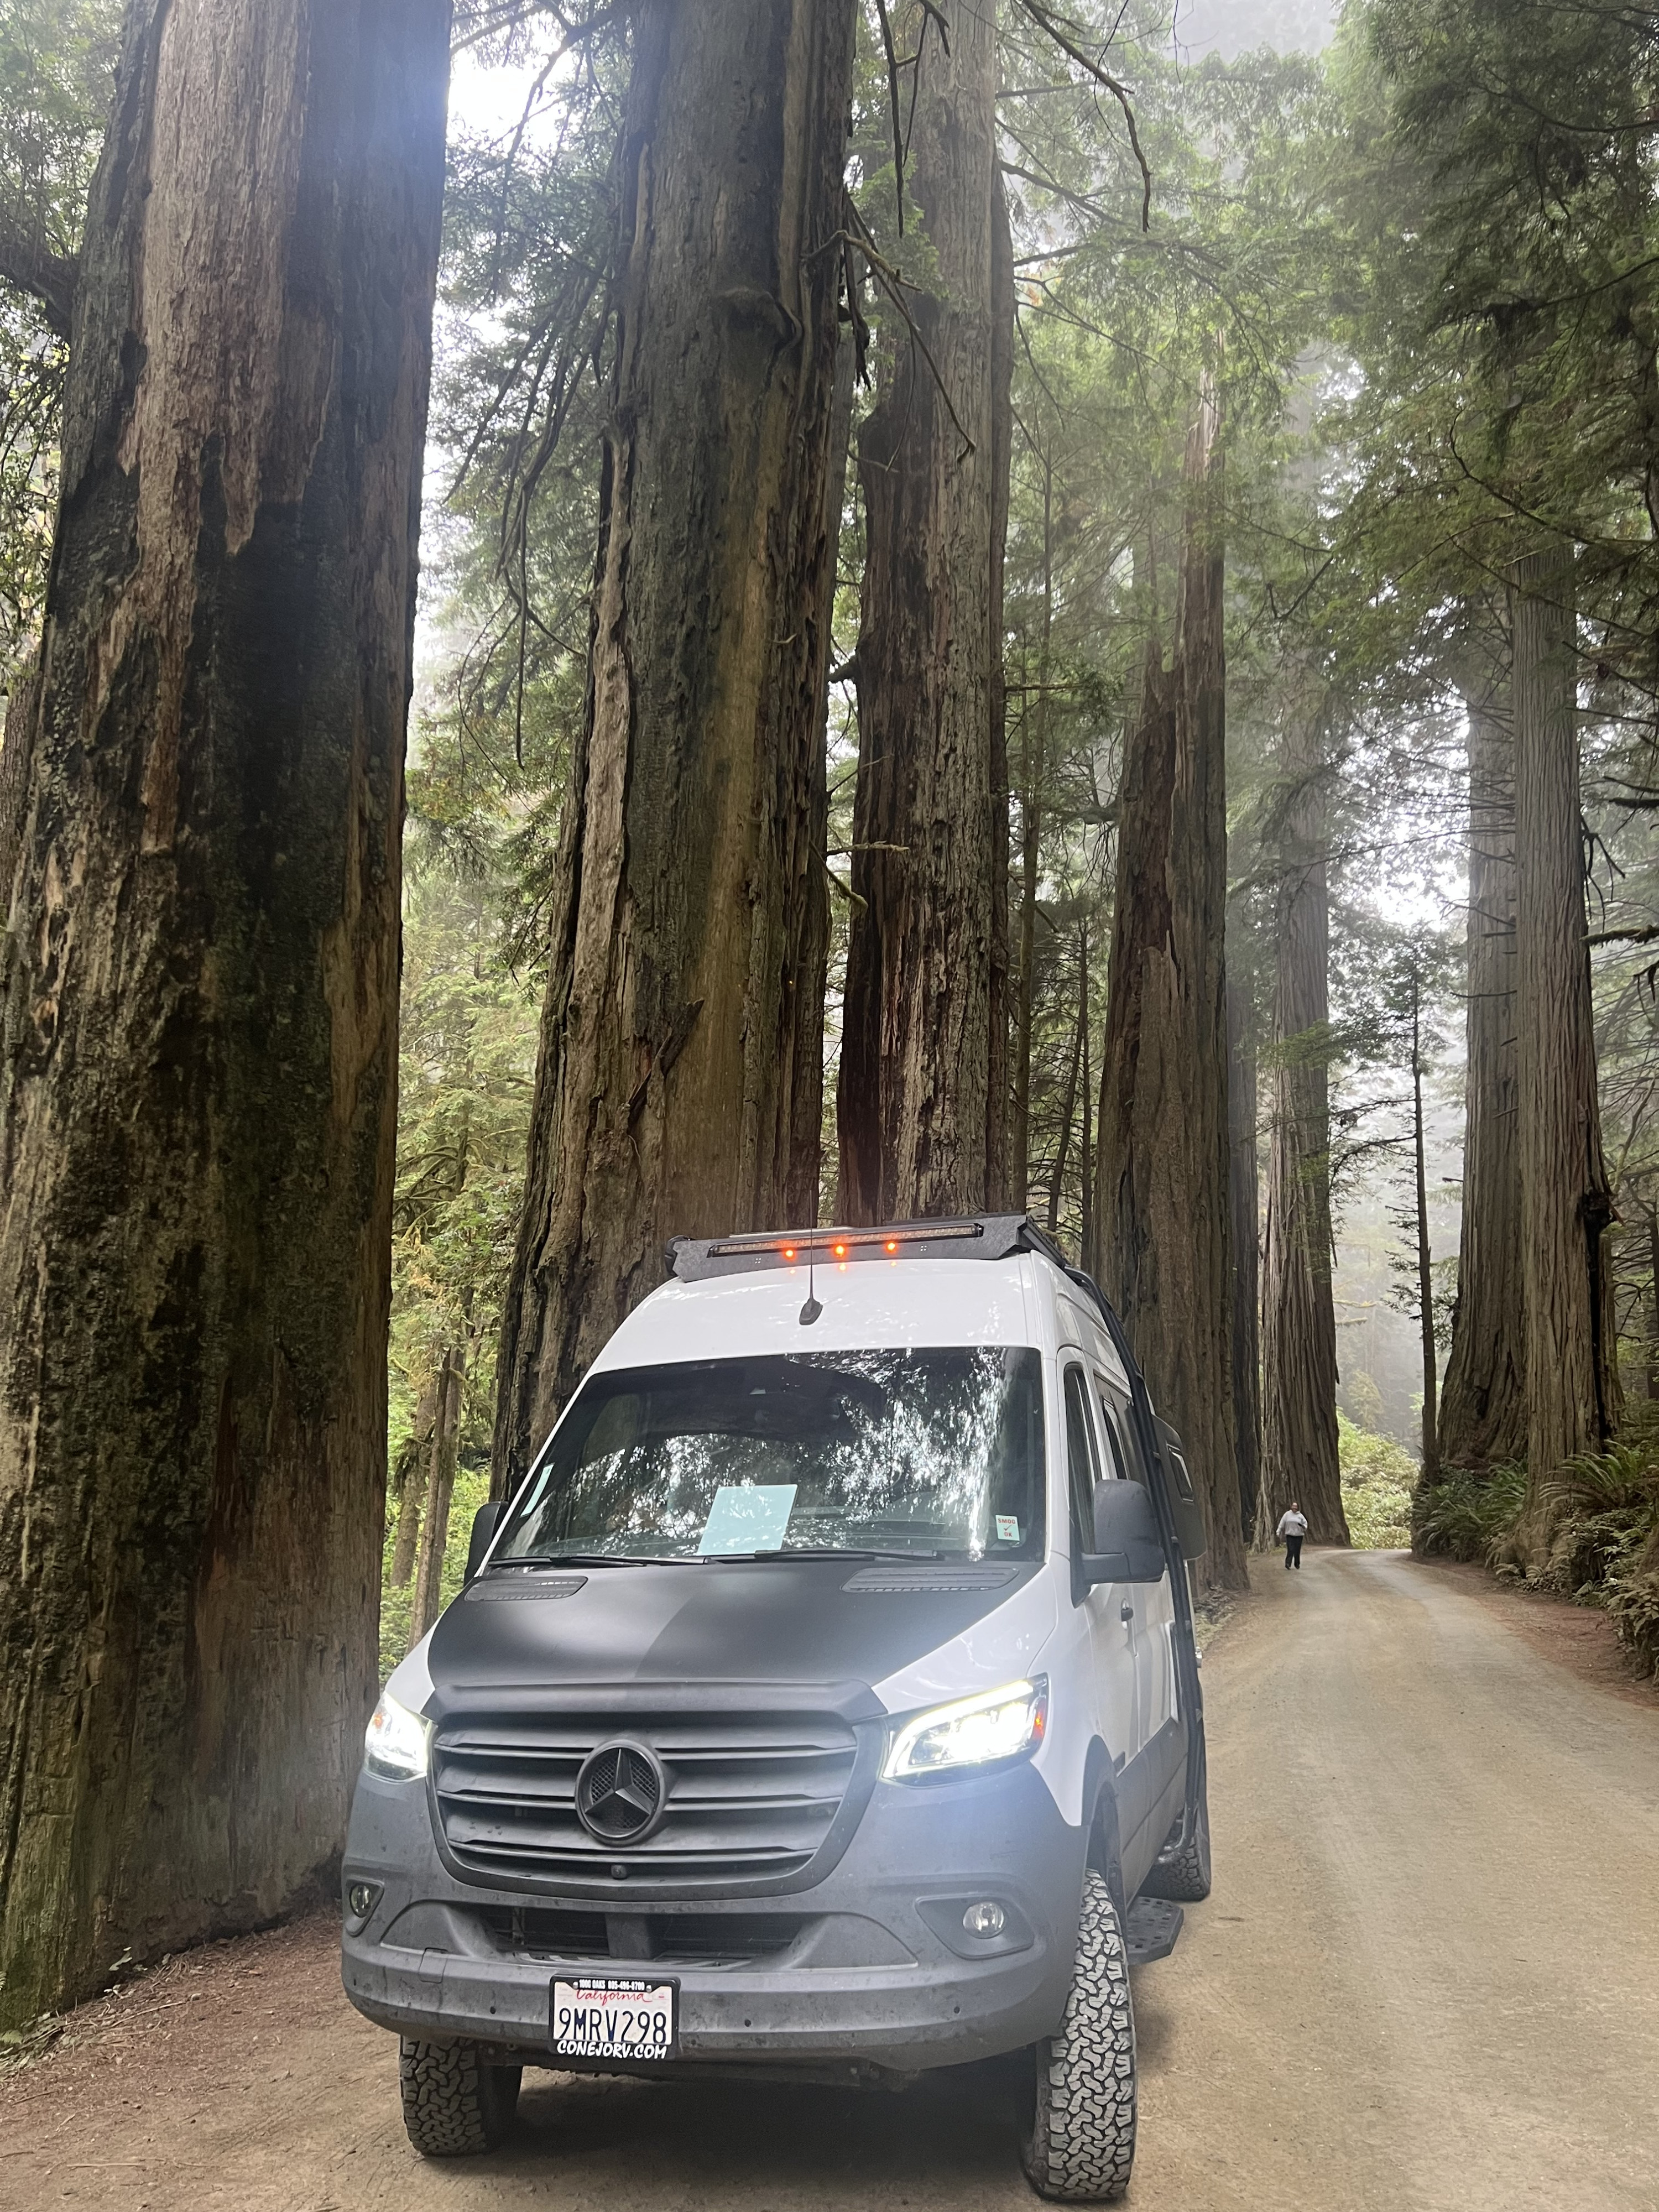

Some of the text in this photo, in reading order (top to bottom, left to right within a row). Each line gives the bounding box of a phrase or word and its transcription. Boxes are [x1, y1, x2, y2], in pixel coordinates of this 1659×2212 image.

[592, 1980, 606, 1989] OAKS
[576, 1989, 653, 2006] California
[559, 2007, 666, 2044] 9MRV298
[557, 2040, 667, 2059] CONEJORV.COM
